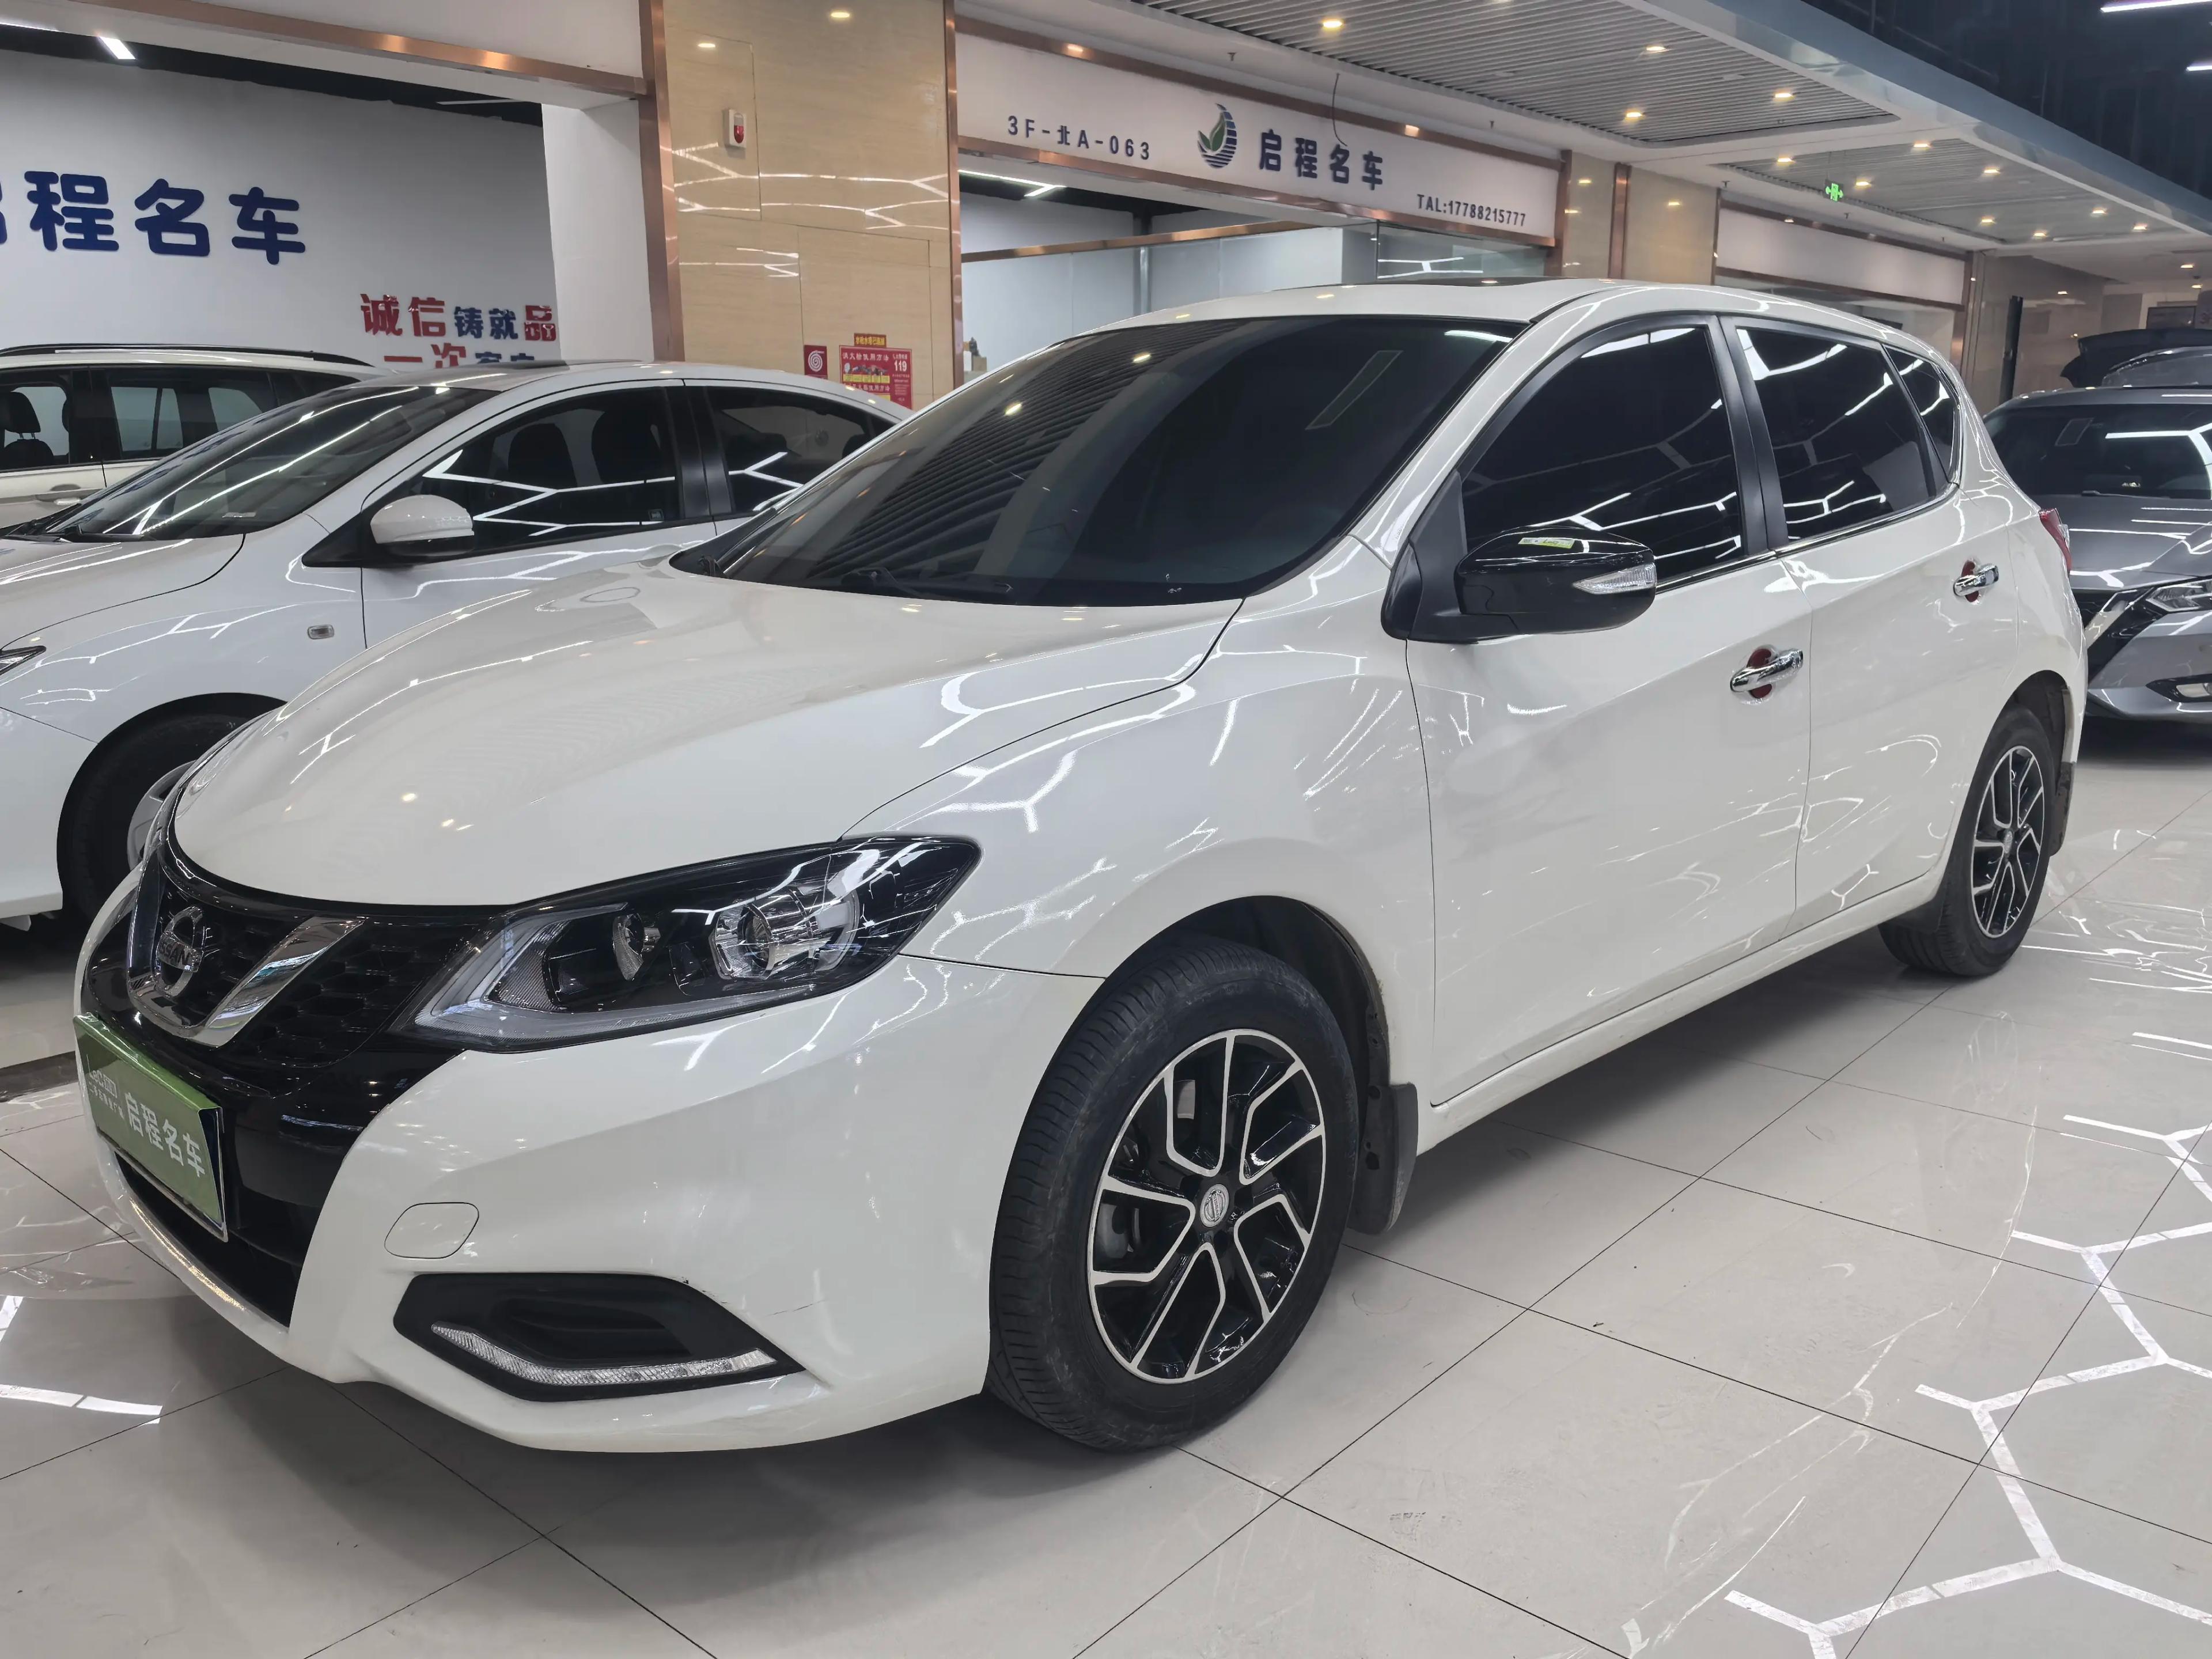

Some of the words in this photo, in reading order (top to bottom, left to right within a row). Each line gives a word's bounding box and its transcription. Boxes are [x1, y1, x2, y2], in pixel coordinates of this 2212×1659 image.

[1259, 128, 1382, 191] 启程名车
[0, 171, 305, 264] 程名车
[1416, 194, 1526, 226] TAL:17788215777
[359, 293, 556, 342] 诚信铸就品
[384, 343, 535, 368] 一次
[894, 360, 907, 372] 119
[124, 1092, 205, 1177] 启程名车
